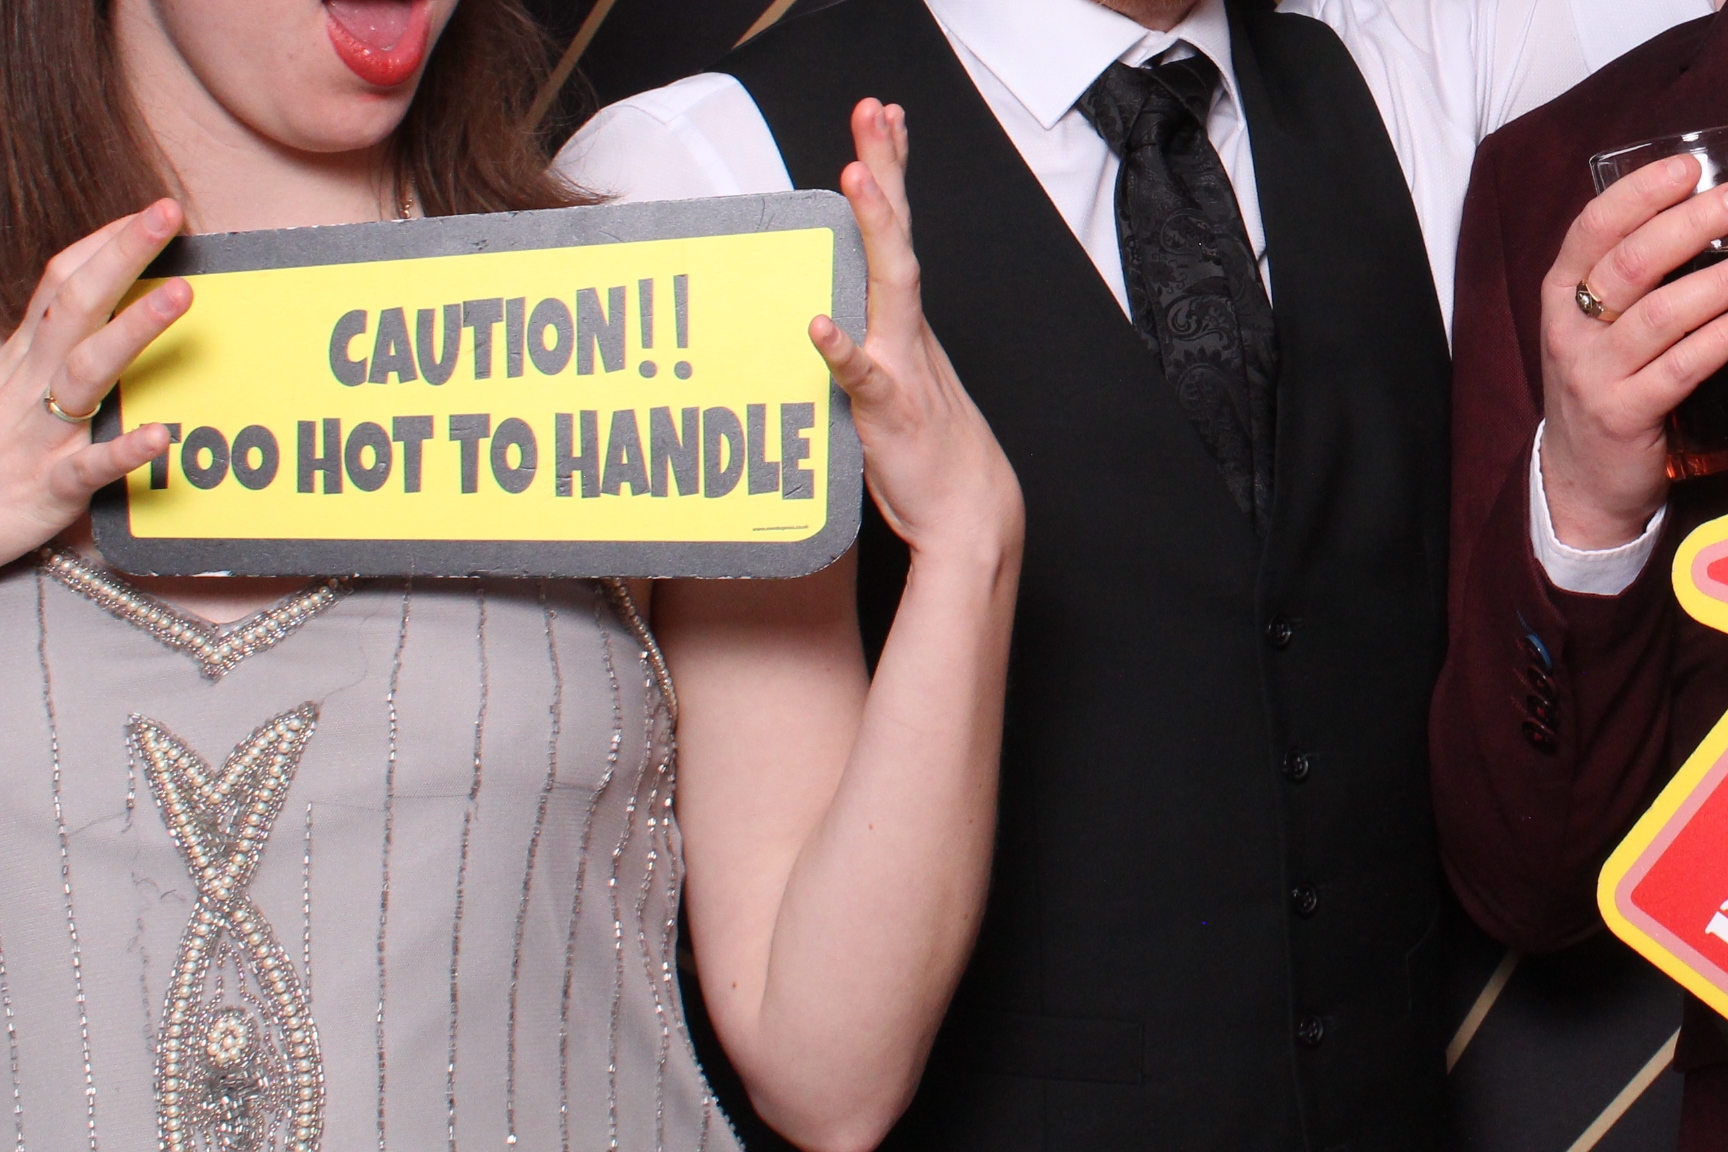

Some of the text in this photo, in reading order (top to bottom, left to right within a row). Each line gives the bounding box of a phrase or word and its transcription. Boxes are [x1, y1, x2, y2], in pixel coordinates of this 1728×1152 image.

[328, 274, 690, 387] CAUTION!!
[296, 414, 434, 495] HOT
[448, 413, 538, 494] TO
[554, 402, 815, 501] HANDLE
